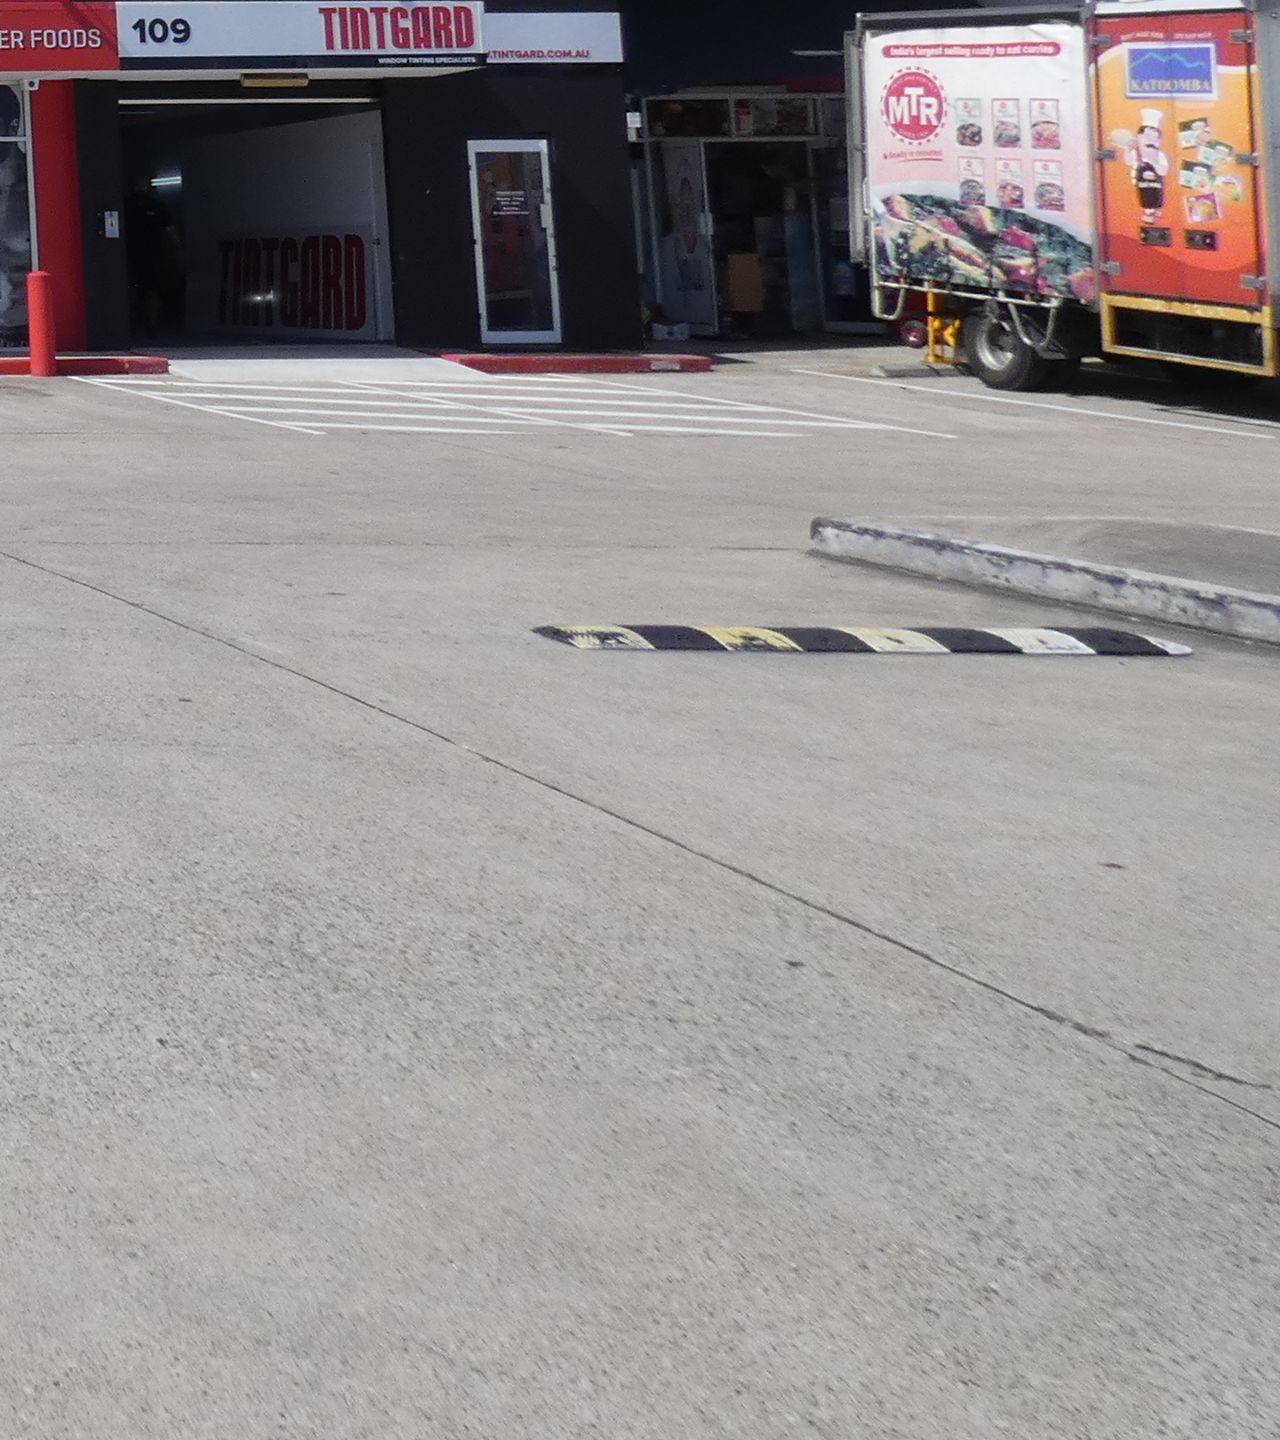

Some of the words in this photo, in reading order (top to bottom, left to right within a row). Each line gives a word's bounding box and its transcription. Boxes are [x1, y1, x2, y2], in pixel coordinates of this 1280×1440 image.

[30, 28, 102, 50] FOODS
[131, 18, 192, 44] 109
[318, 6, 475, 51] TINTGARD
[487, 50, 589, 59] .TINTGARD.COM.AU
[888, 87, 938, 126] MTR
[218, 234, 366, 330] TINTGARD
